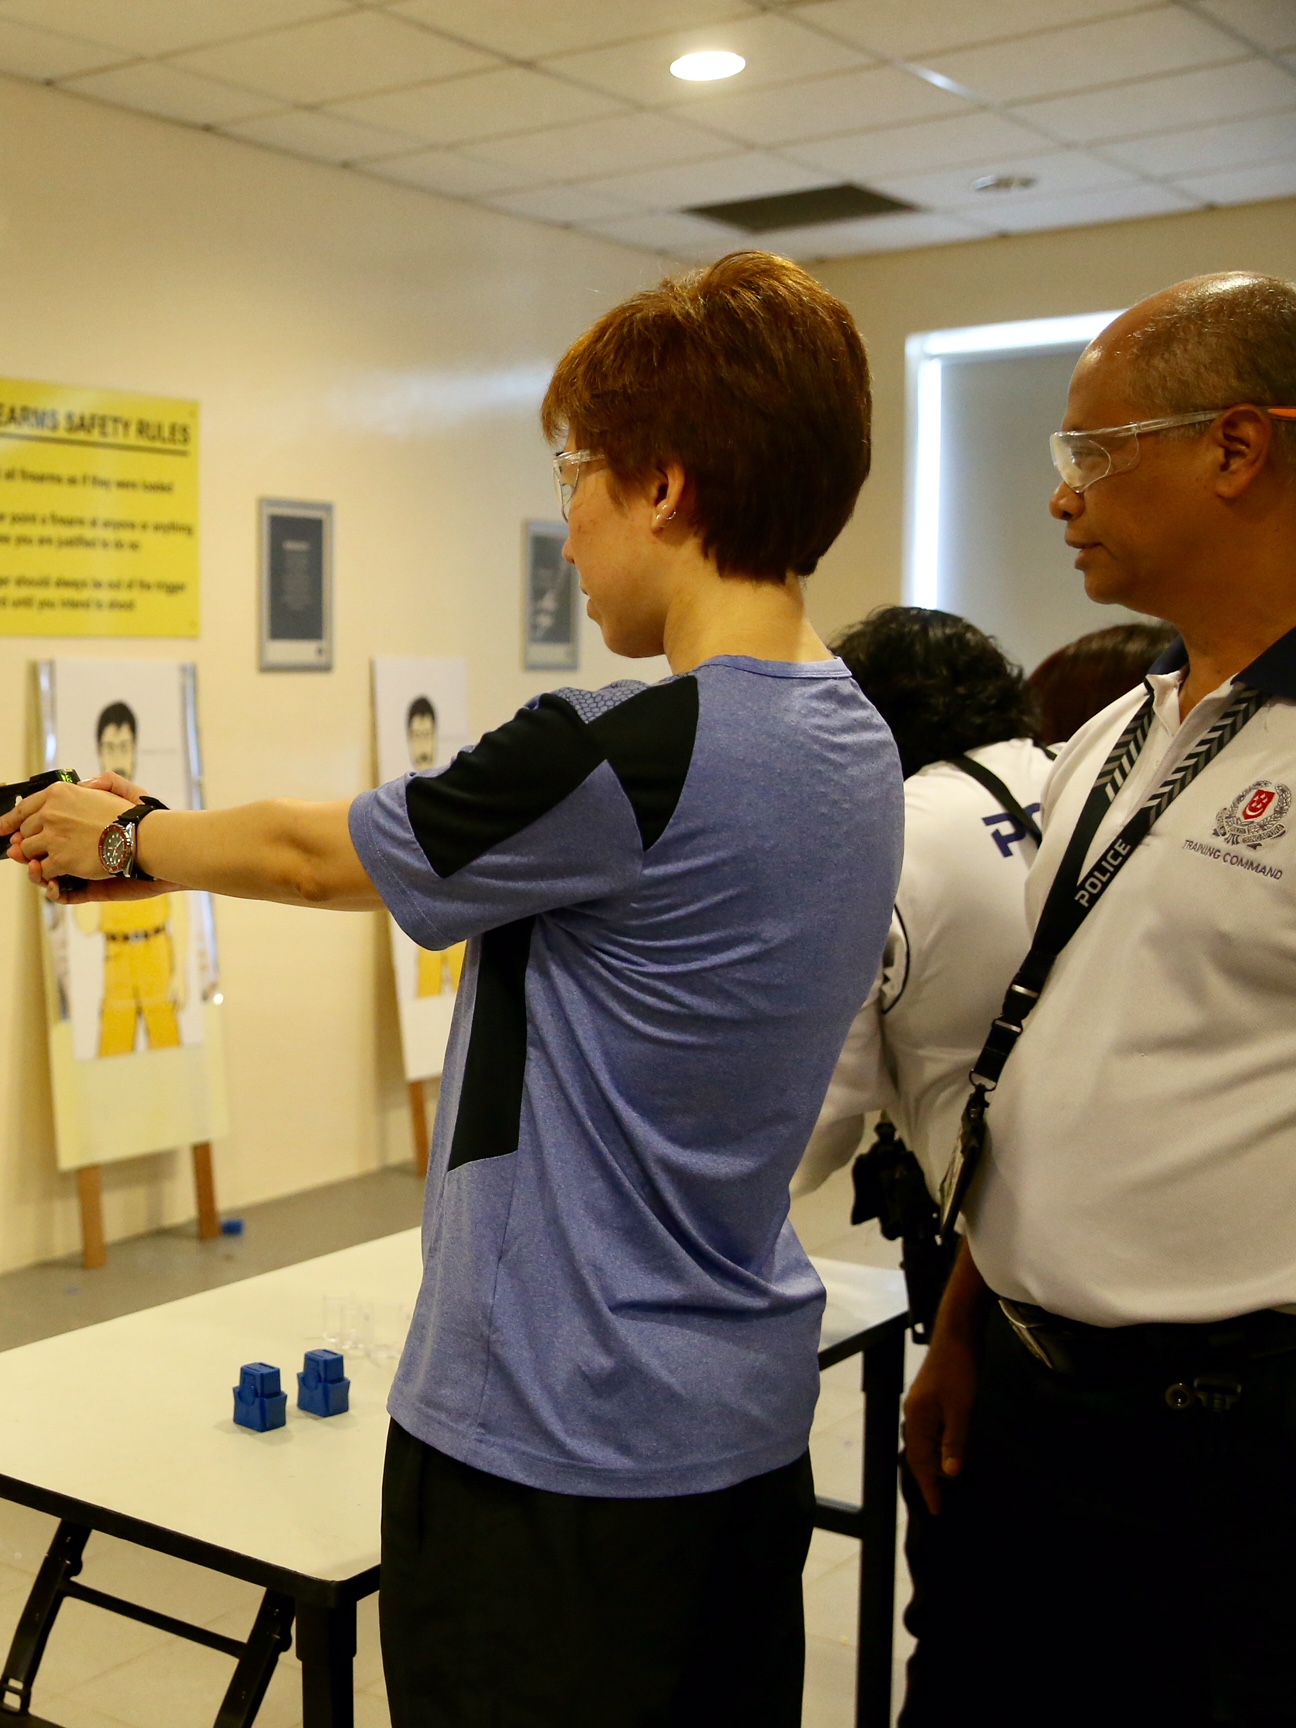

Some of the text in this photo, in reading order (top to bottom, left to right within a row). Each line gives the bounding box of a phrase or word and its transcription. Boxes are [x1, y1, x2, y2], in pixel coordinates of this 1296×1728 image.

[64, 410, 132, 439] SAFETY
[135, 417, 191, 446] RULES
[4, 467, 16, 482] all
[20, 467, 63, 485] firearms
[91, 474, 111, 492] they
[115, 479, 138, 491] were
[9, 511, 37, 528] point
[152, 520, 194, 540] anything
[14, 534, 34, 550] you
[37, 534, 55, 547] are
[13, 574, 51, 589] should
[54, 575, 89, 592] always
[37, 598, 57, 613] you
[1074, 838, 1131, 908] POLICE
[1182, 839, 1283, 880] TRAINING COMMAND
